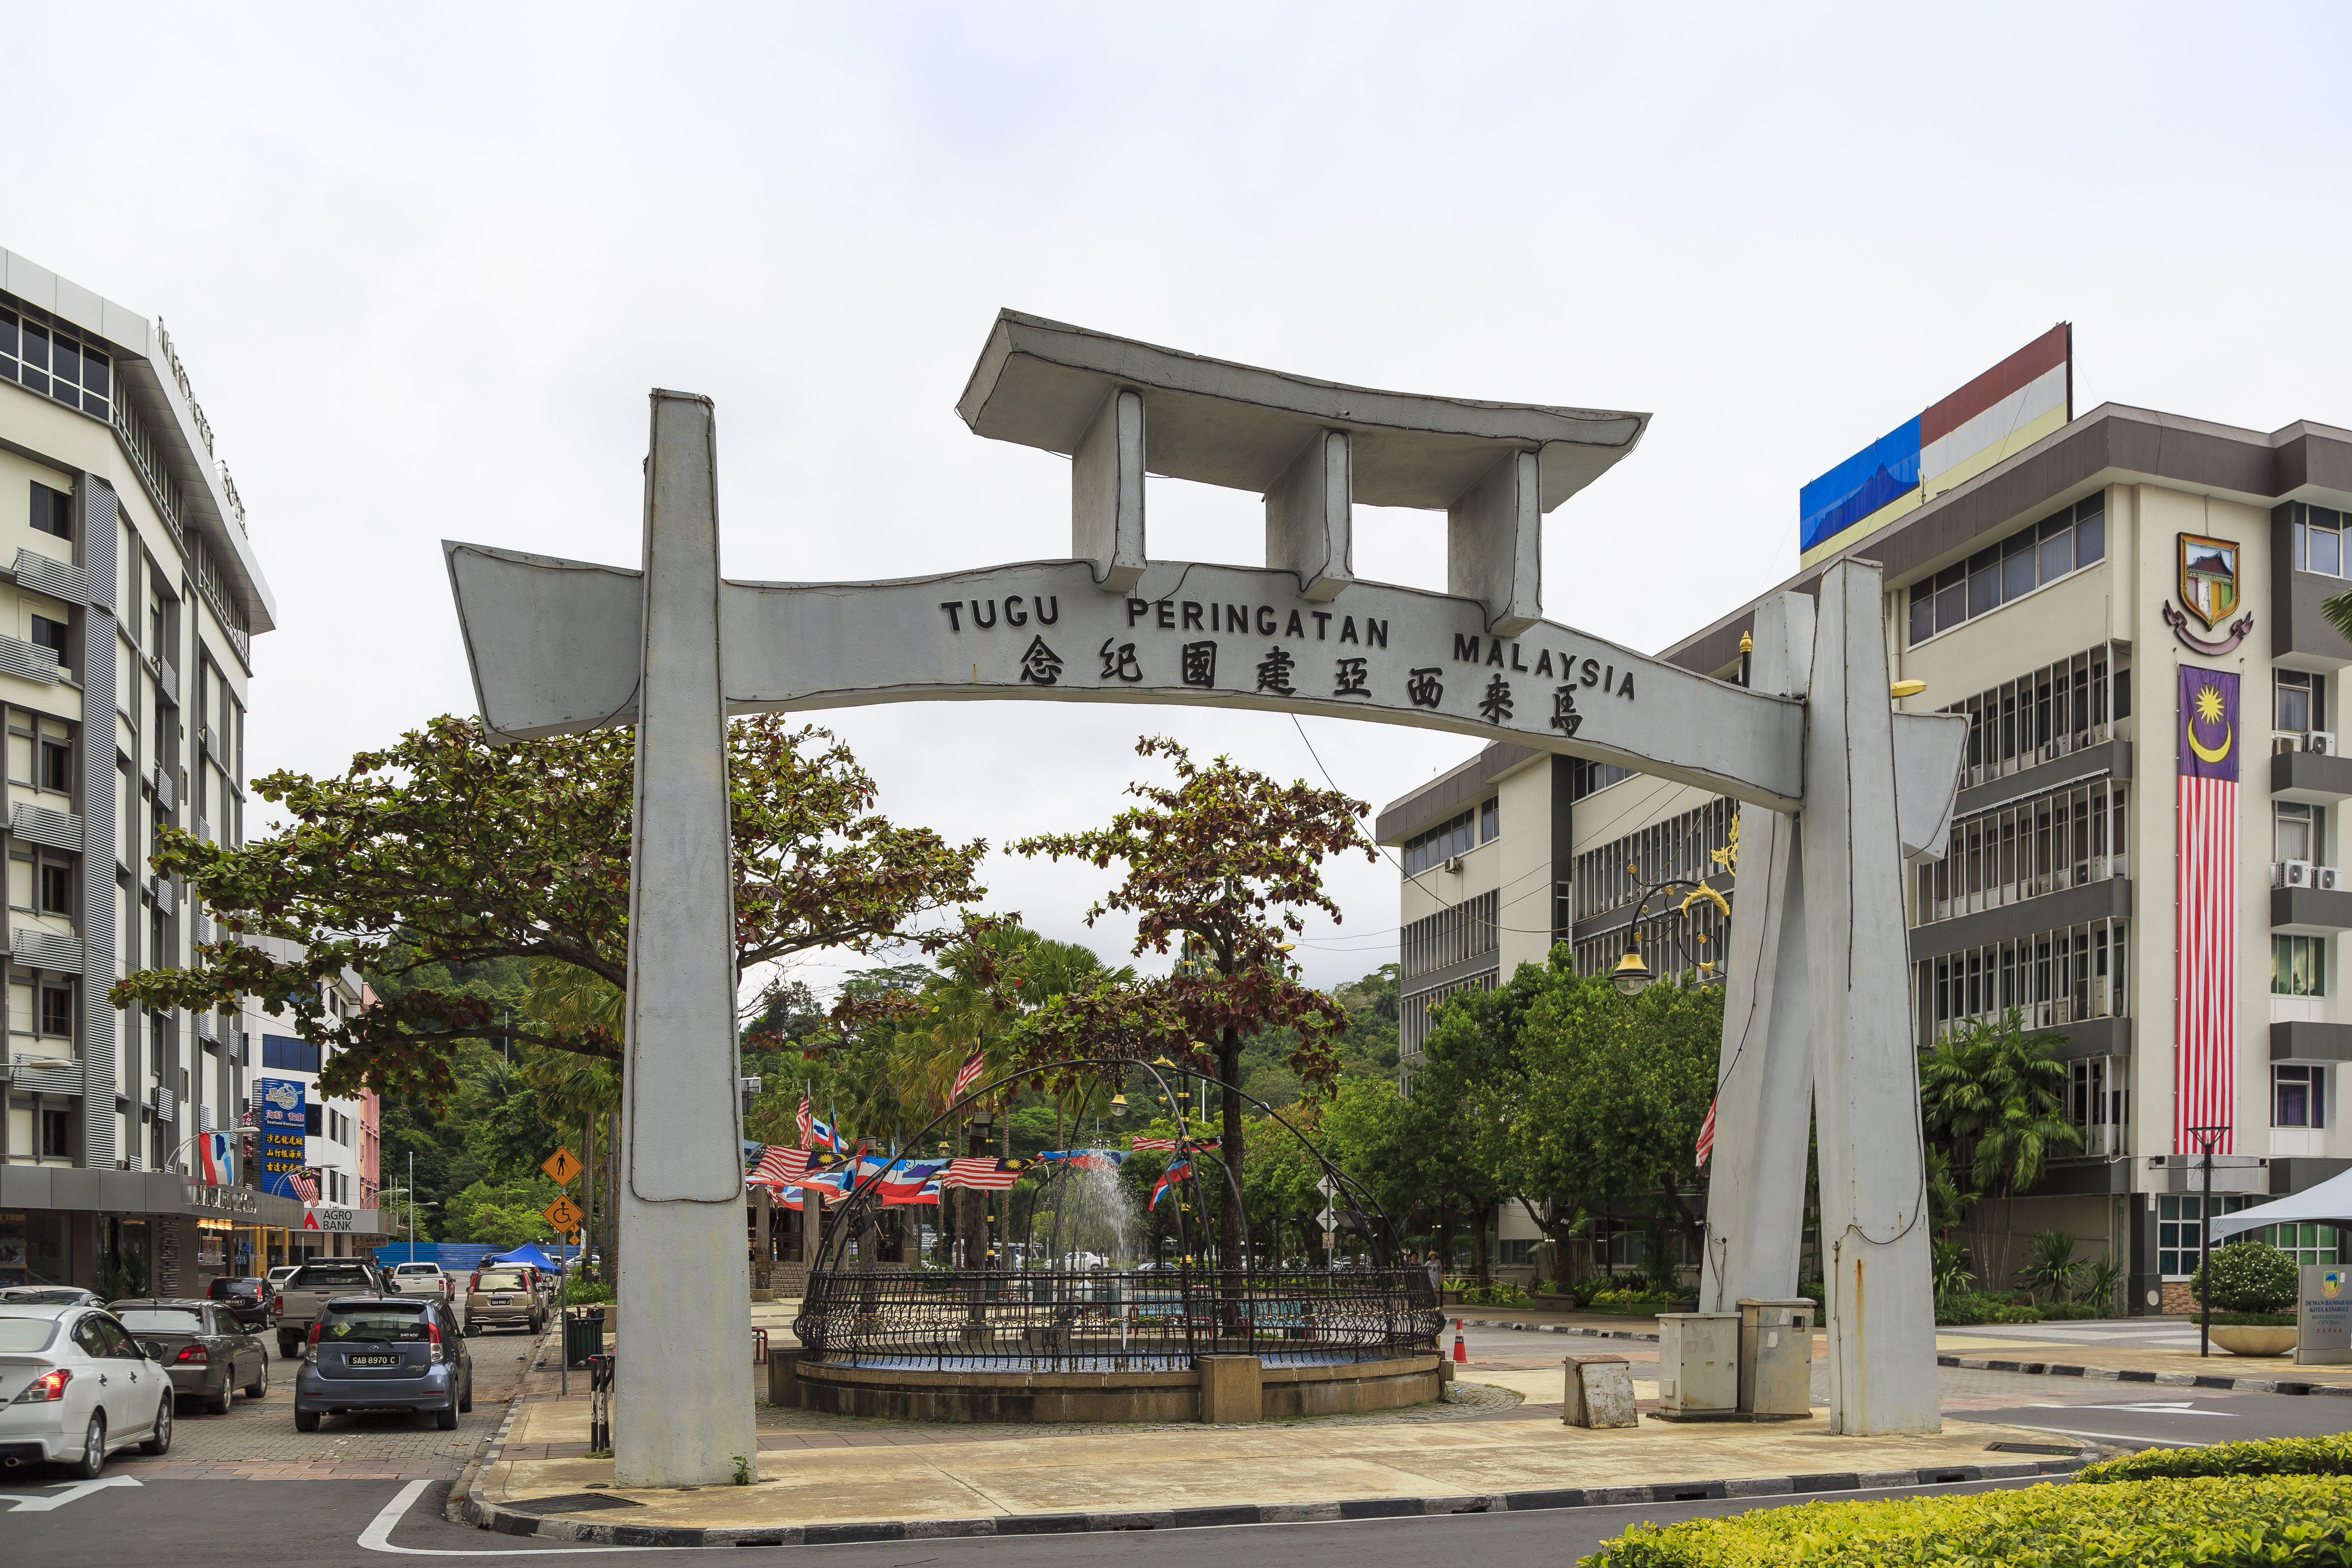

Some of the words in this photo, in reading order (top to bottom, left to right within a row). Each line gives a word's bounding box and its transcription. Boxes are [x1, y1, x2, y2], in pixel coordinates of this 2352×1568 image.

[940, 595, 1059, 632] TUGU
[1127, 598, 1389, 649] PERINGATAN
[1454, 633, 1635, 701] MALAYSIA
[267, 1094, 295, 1102] Restoran
[322, 1210, 352, 1220] AGRO
[322, 1220, 352, 1231] BANK
